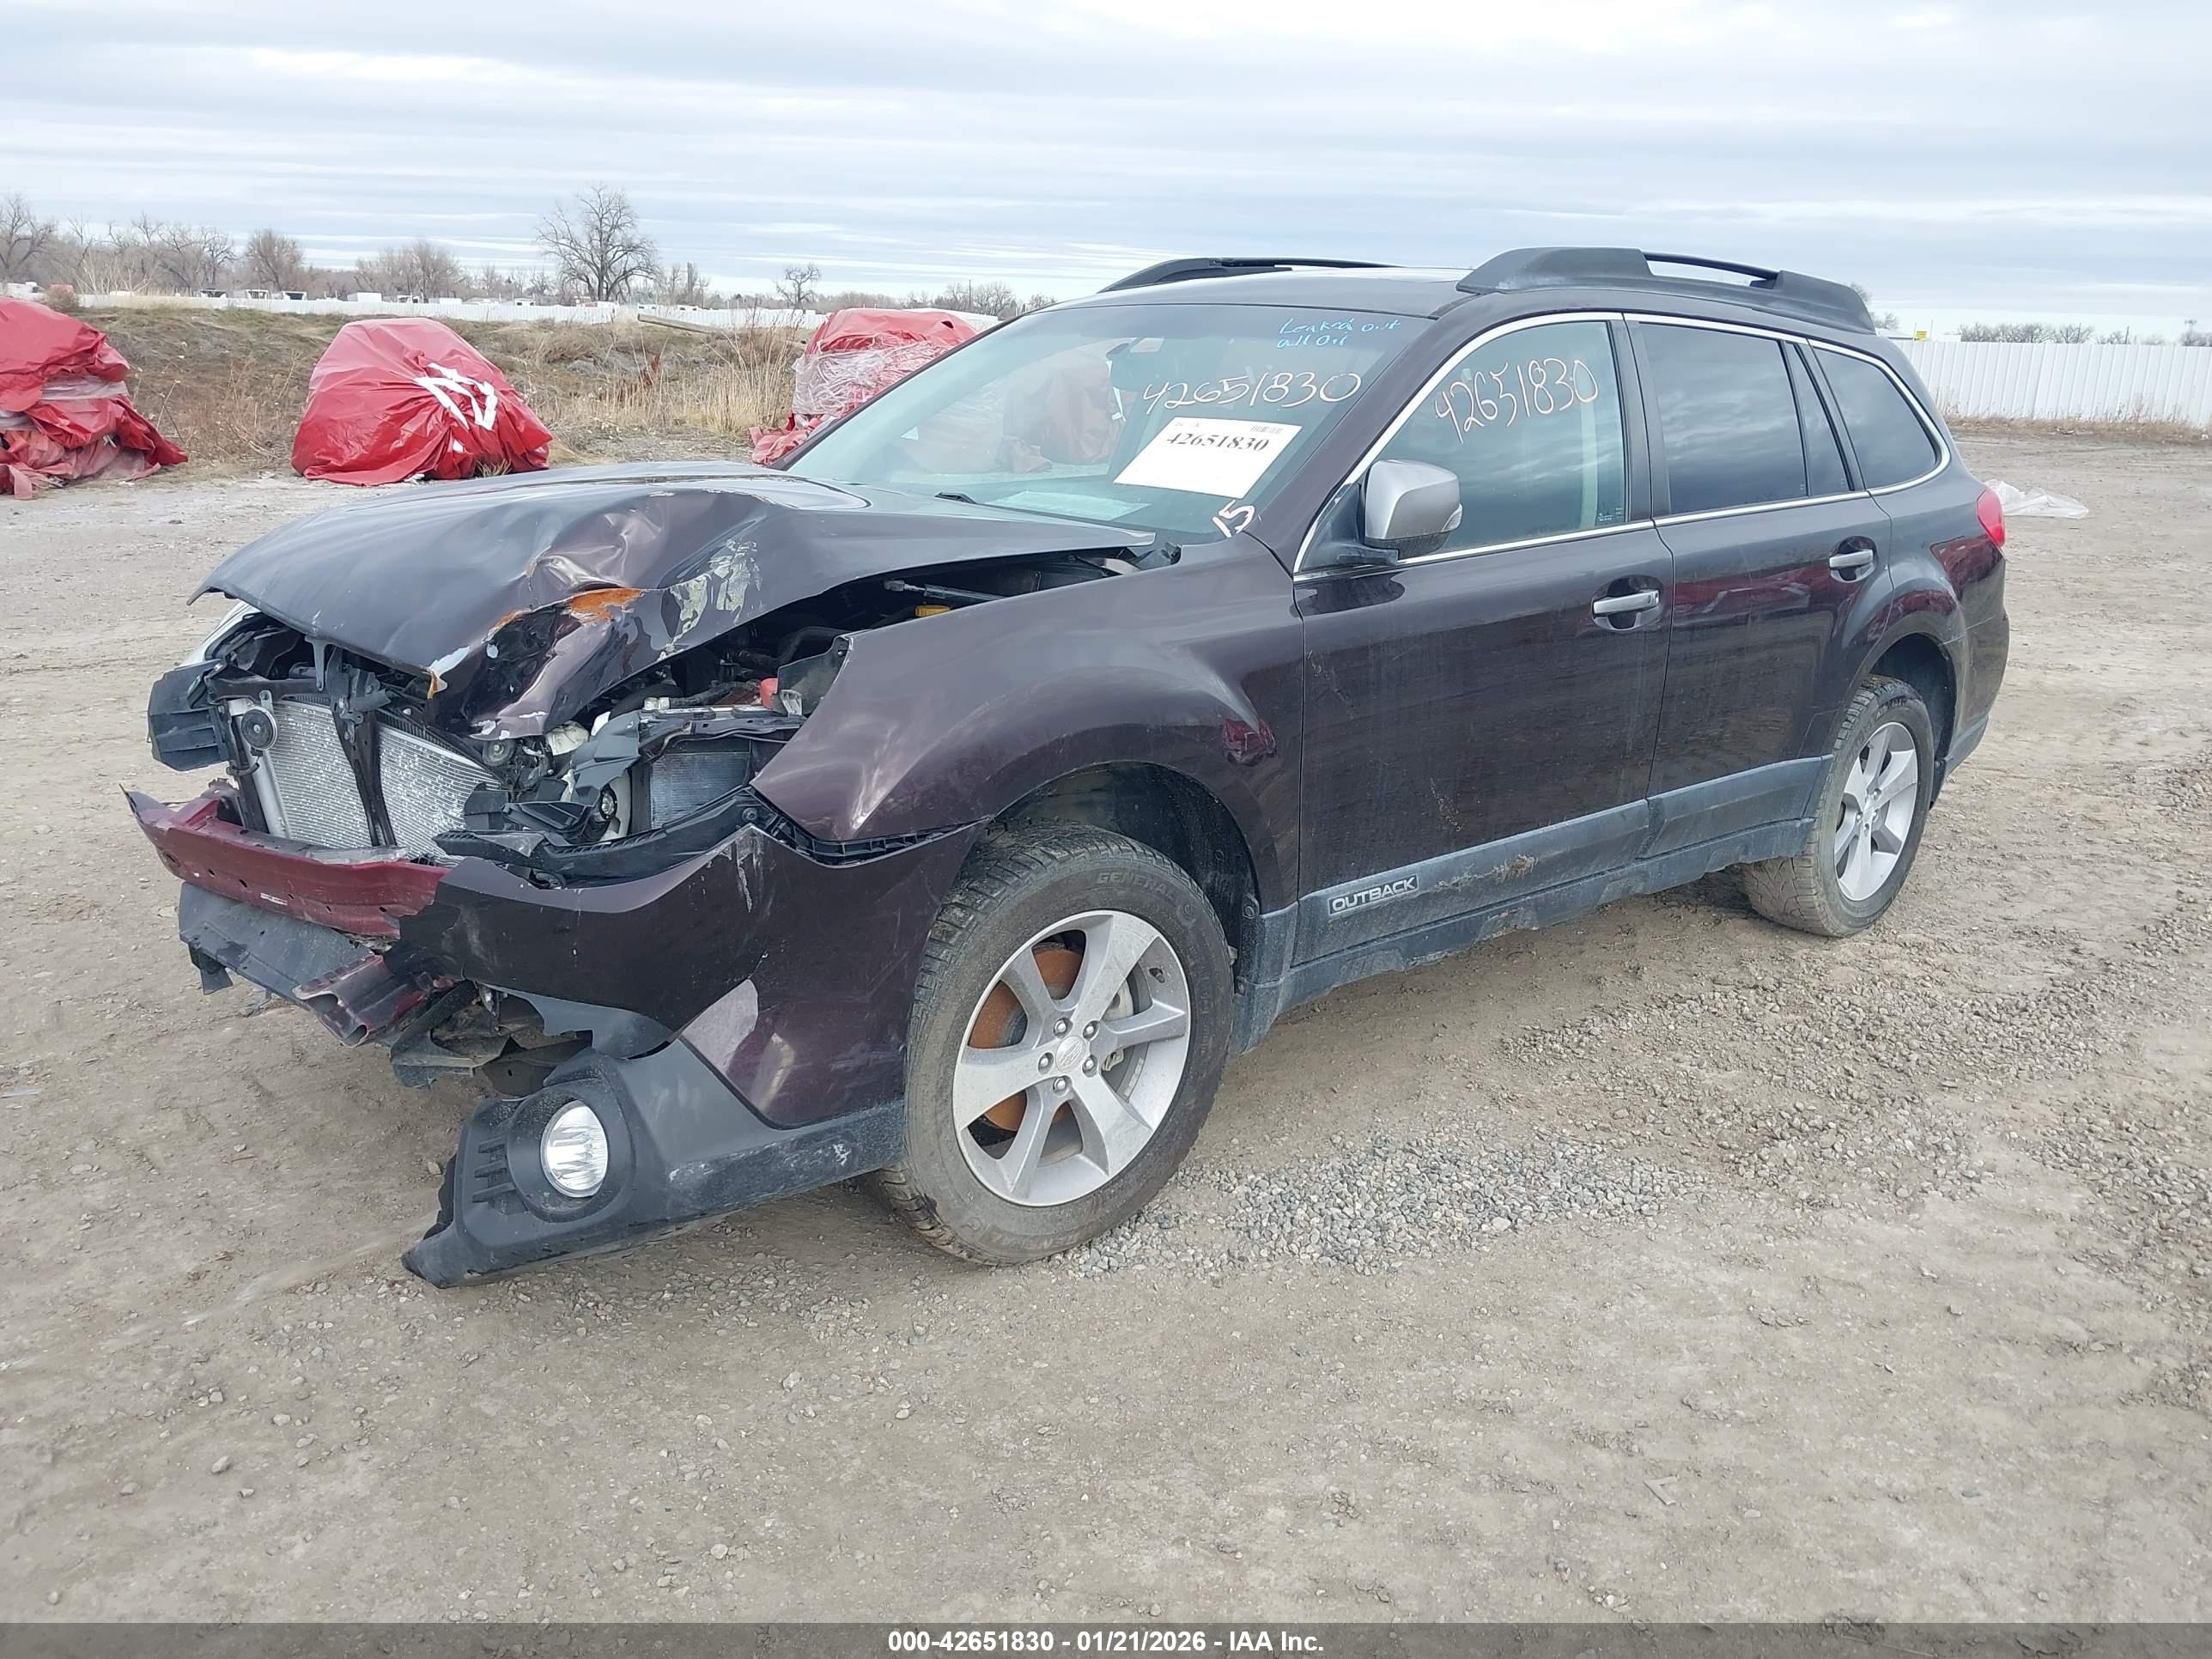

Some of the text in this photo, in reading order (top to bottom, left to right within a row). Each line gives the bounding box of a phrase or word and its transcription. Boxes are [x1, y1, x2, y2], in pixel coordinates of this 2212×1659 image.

[1143, 372, 1361, 415] 42651830
[1435, 357, 1598, 444] 42651830
[1166, 432, 1269, 452] 42651830
[1332, 876, 1416, 912] OUTBACK
